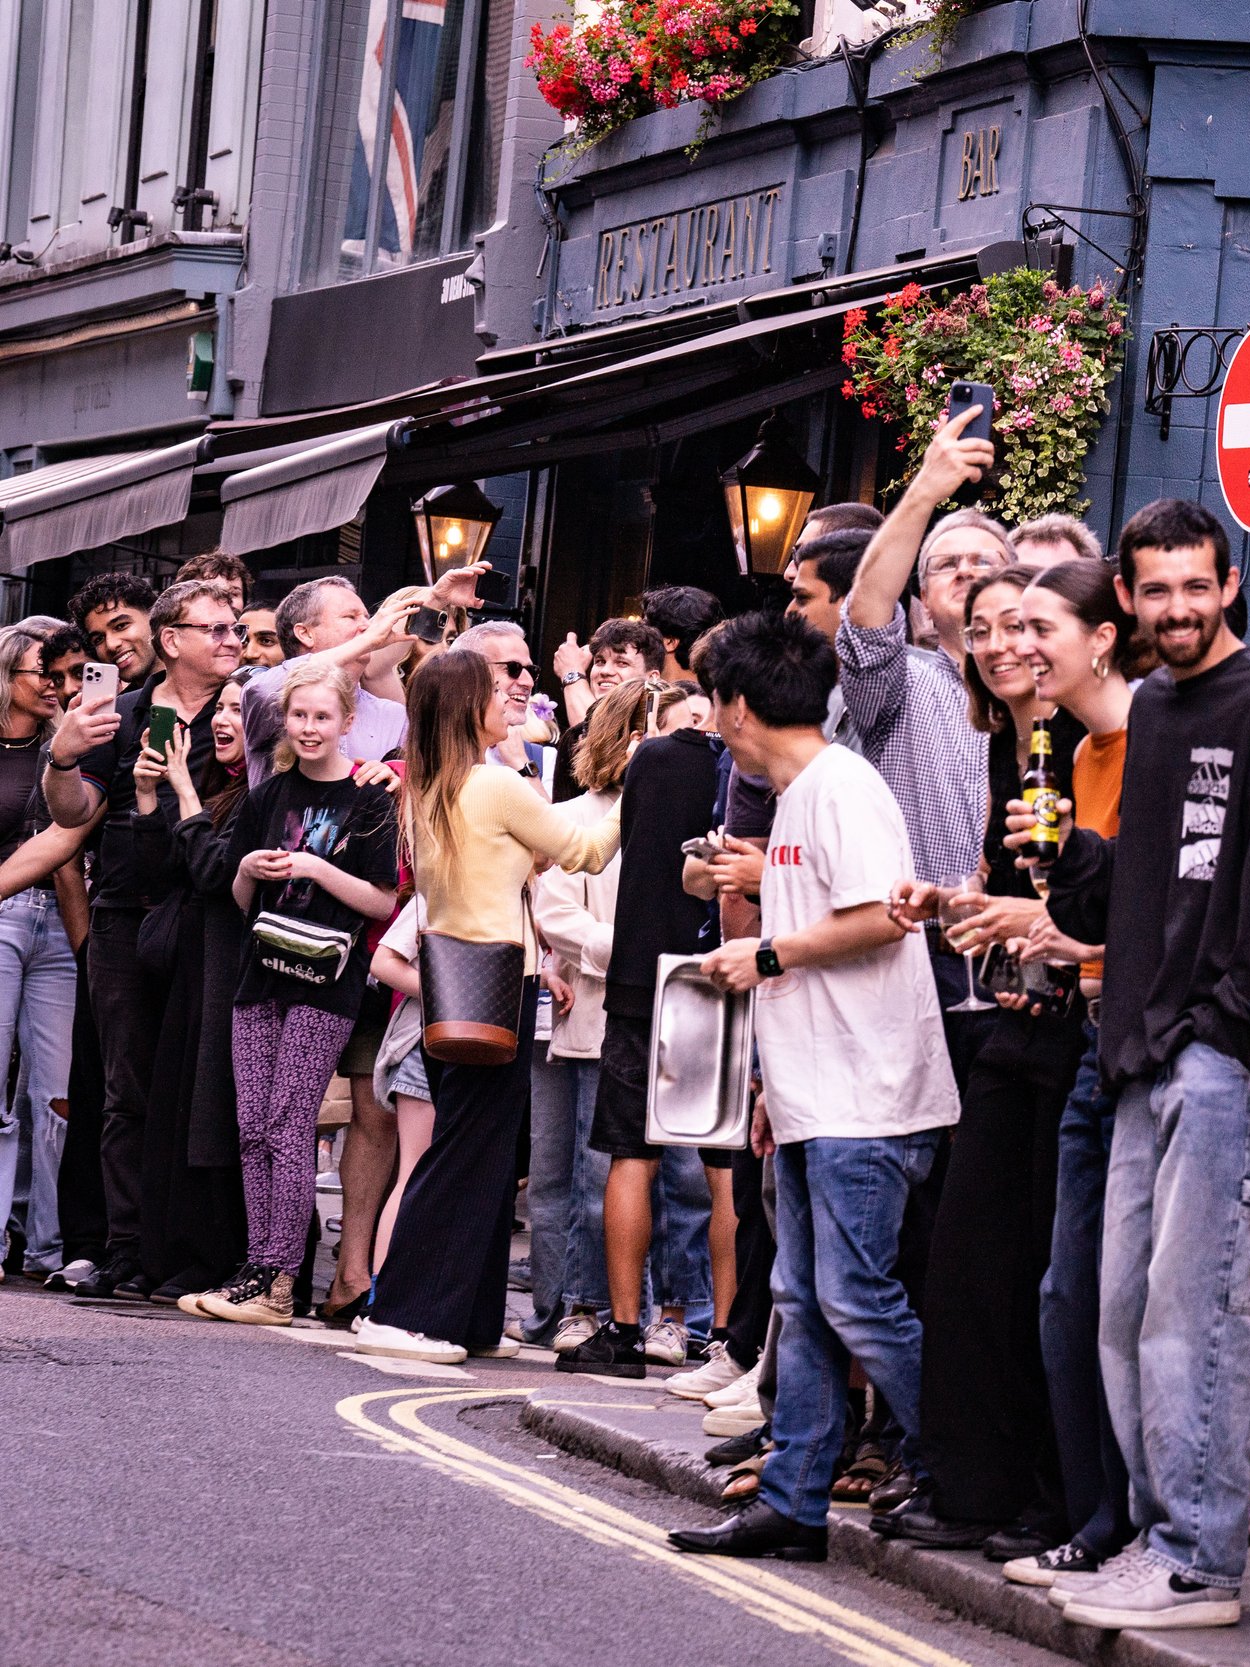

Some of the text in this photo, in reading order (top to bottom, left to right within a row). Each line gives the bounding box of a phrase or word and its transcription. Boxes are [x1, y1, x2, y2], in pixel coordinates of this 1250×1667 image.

[958, 126, 1001, 200] BAR
[597, 188, 781, 309] RESTAURANT
[262, 957, 326, 984] ellesse
